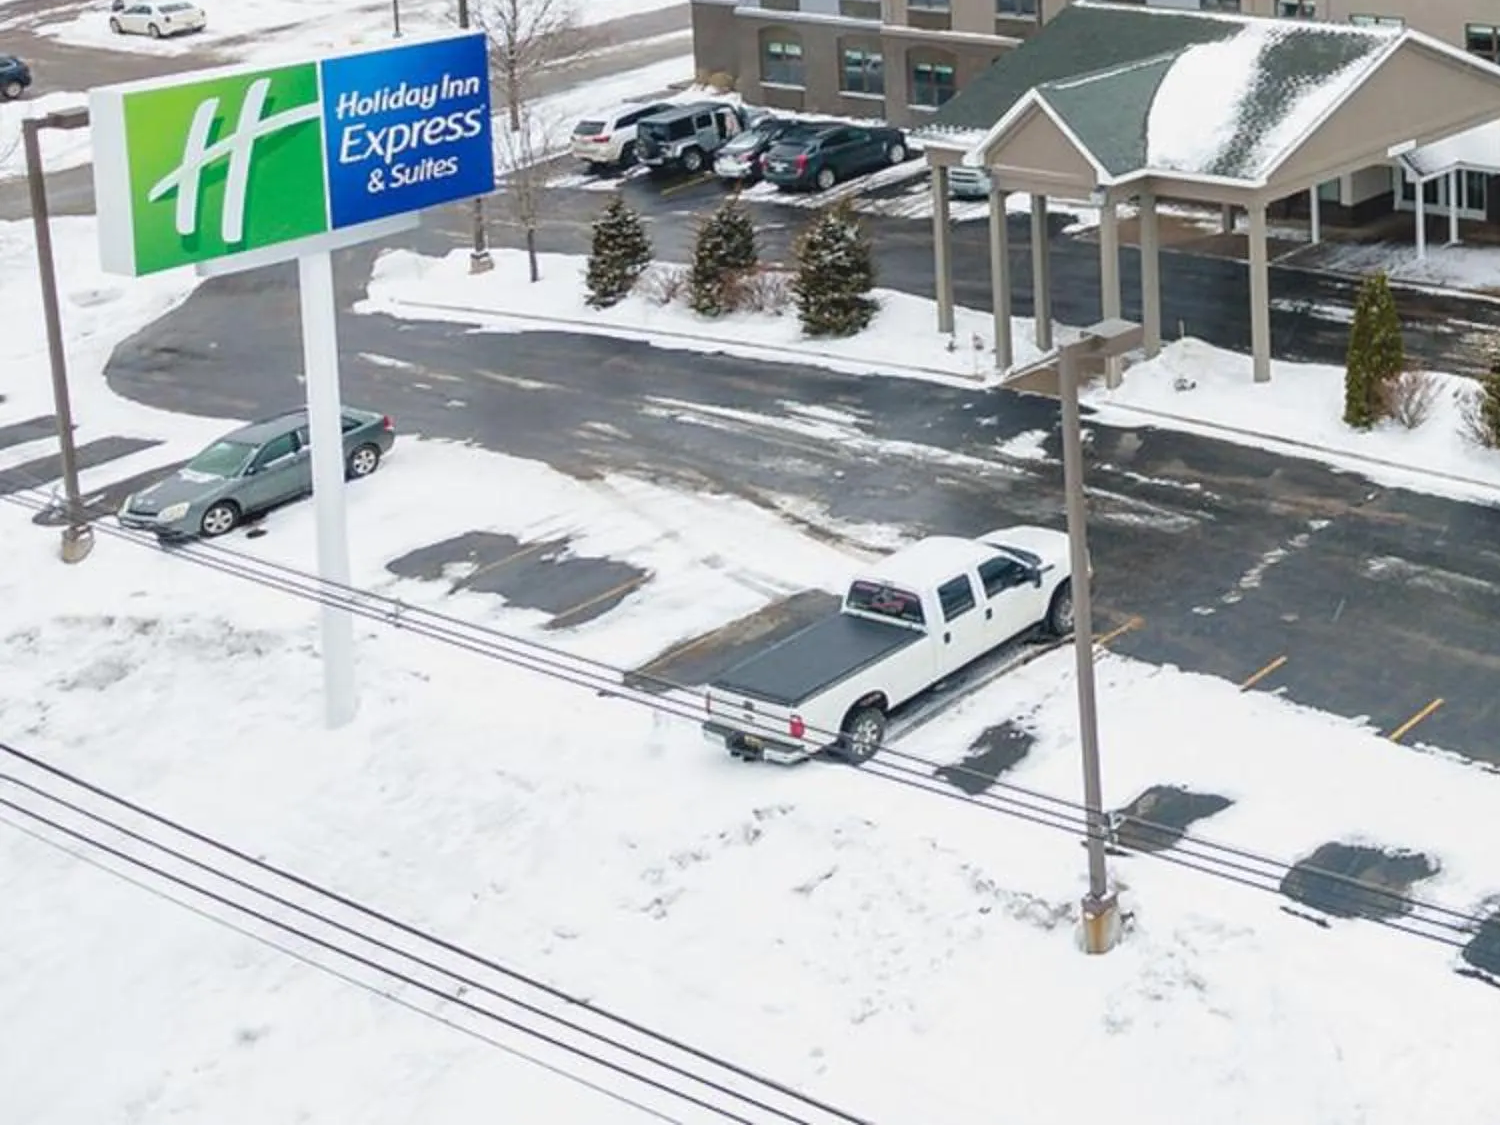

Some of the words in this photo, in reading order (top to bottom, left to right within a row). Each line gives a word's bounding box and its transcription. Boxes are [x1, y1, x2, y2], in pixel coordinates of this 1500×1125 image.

[336, 82, 436, 120] Holiday
[441, 73, 481, 101] Inn
[339, 107, 482, 165] Express
[367, 168, 385, 194] &
[389, 155, 459, 190] Suites
